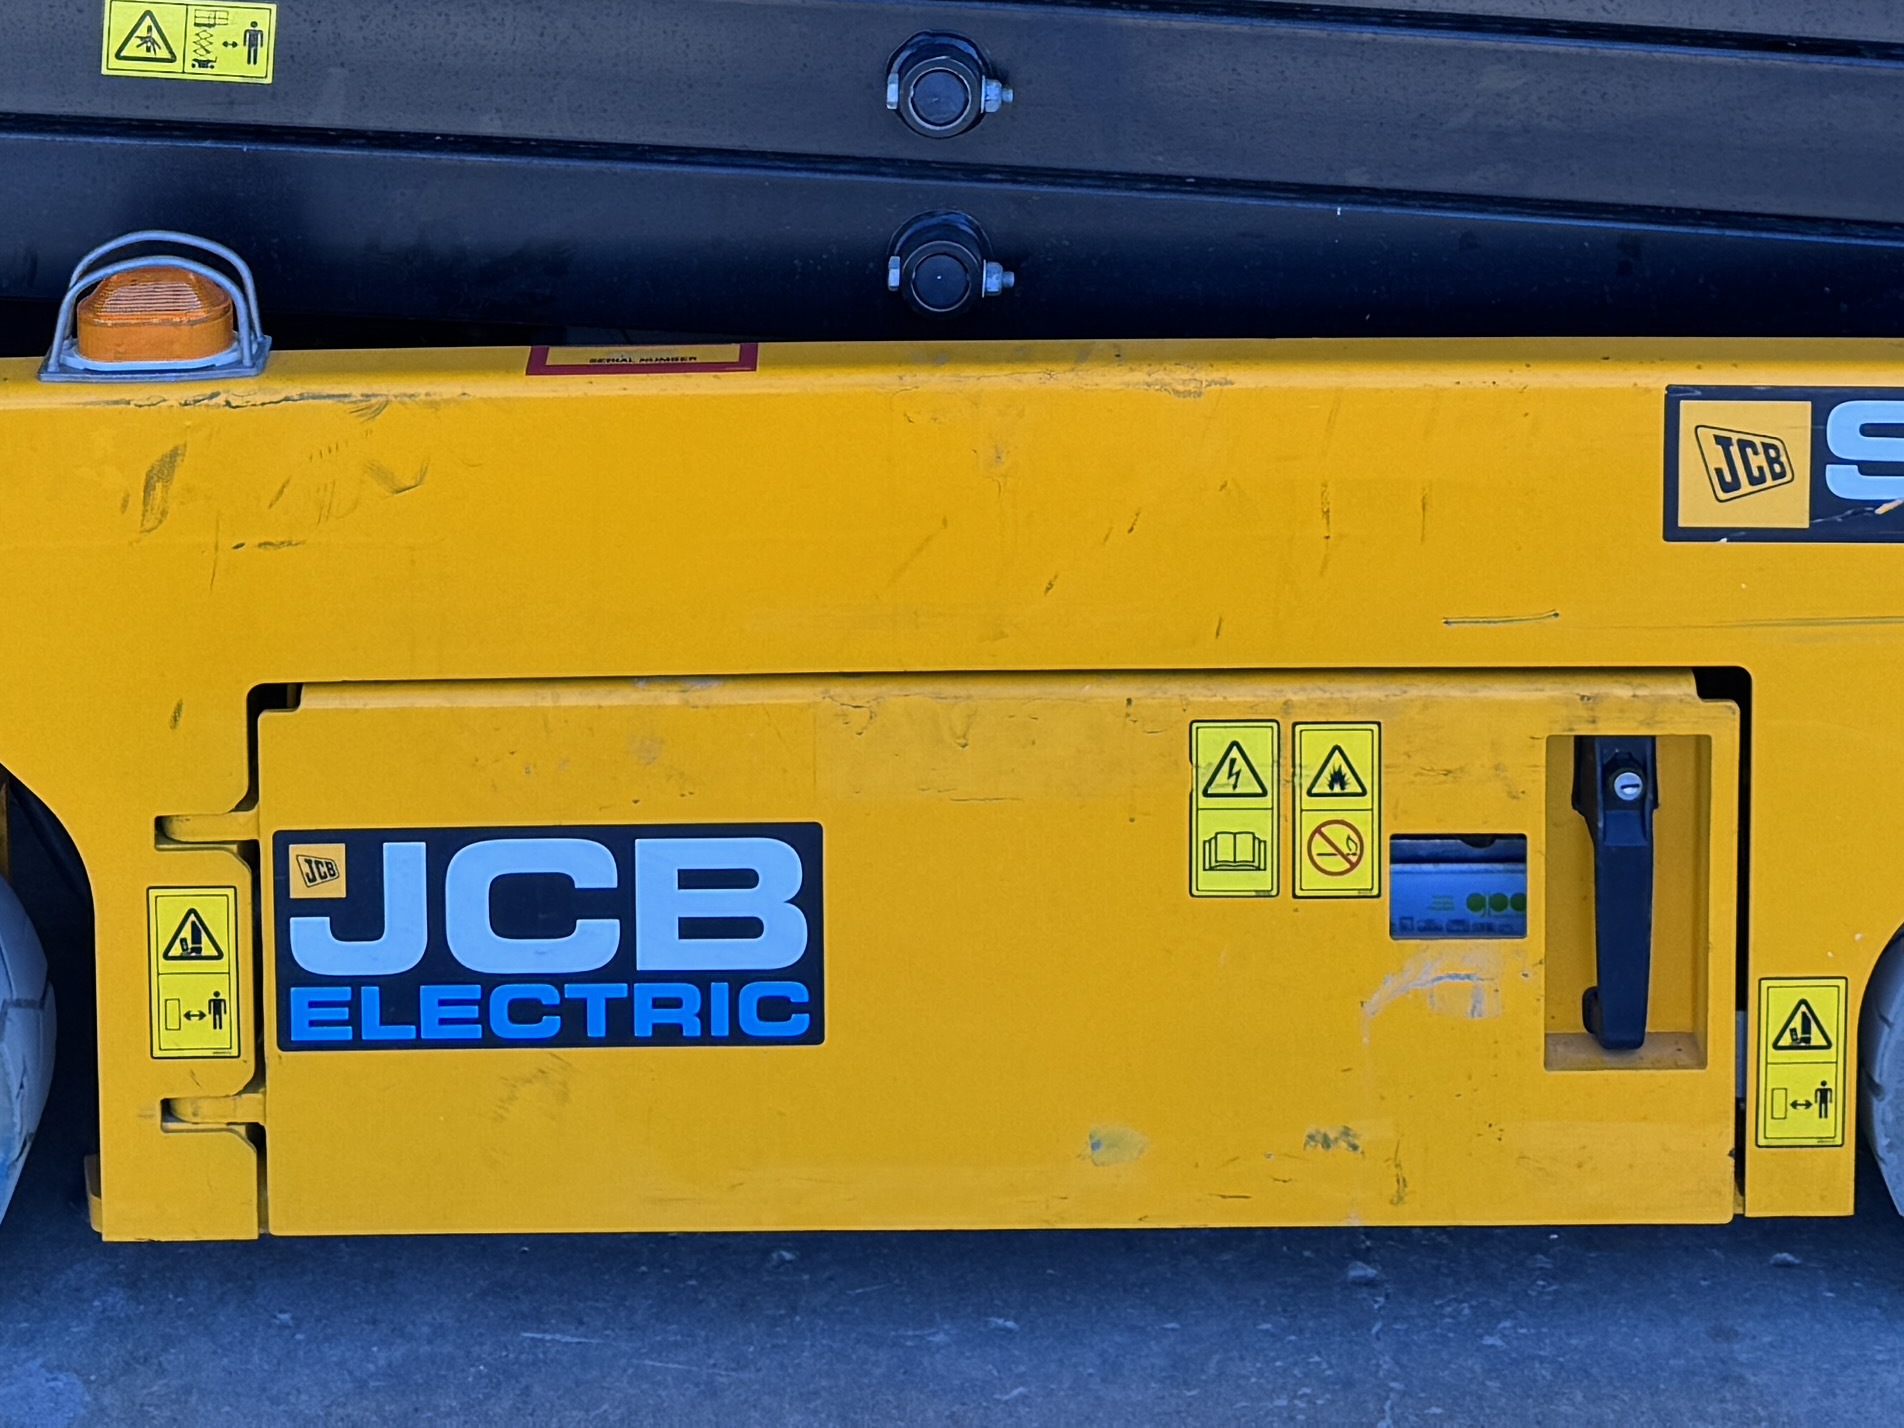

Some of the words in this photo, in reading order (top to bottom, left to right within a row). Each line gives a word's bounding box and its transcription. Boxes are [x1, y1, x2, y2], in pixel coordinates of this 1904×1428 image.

[1713, 434, 1790, 496] JCB
[303, 855, 336, 884] JCB
[290, 837, 809, 976] JCB
[289, 981, 810, 1042] ELECTRIC
